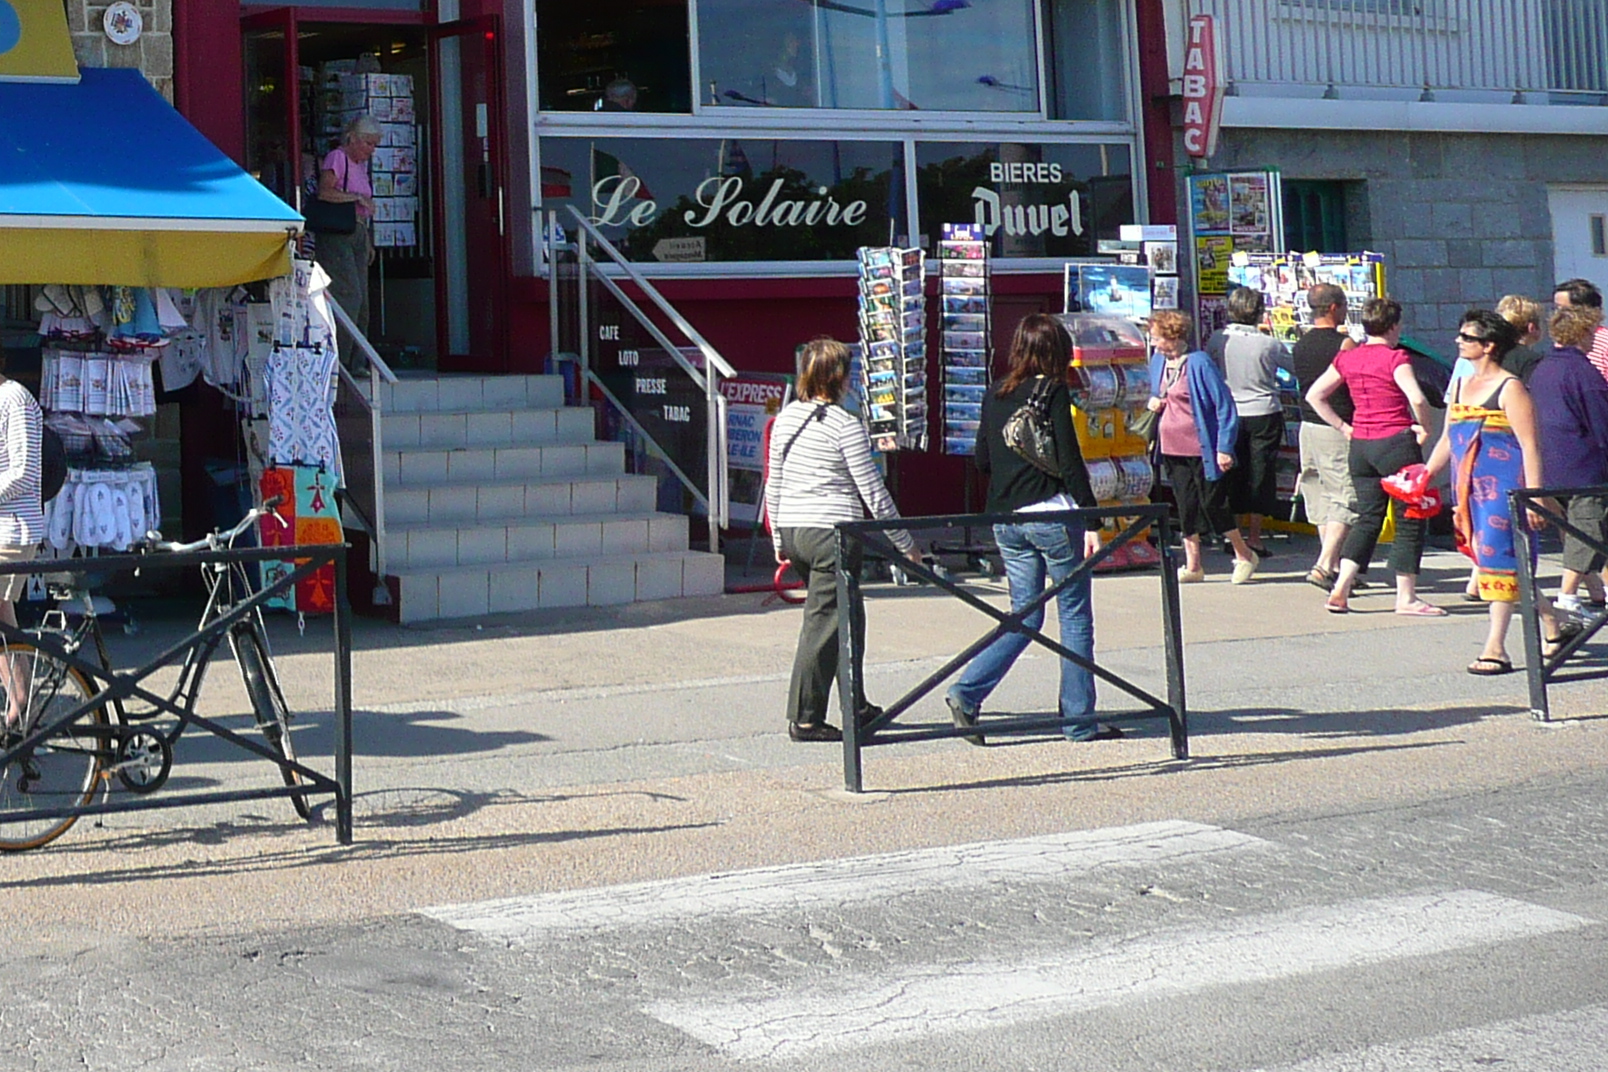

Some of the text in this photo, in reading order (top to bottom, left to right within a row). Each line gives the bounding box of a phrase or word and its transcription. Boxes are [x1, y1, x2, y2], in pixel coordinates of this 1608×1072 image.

[1184, 21, 1206, 152] TABAC
[990, 162, 1063, 183] BIERES
[586, 175, 867, 227] Le Solaire
[971, 186, 1084, 237] Duvel
[599, 325, 620, 340] CAFE
[618, 350, 639, 366] LOTO
[636, 378, 667, 394] PRESSE
[663, 405, 691, 422] TABAC
